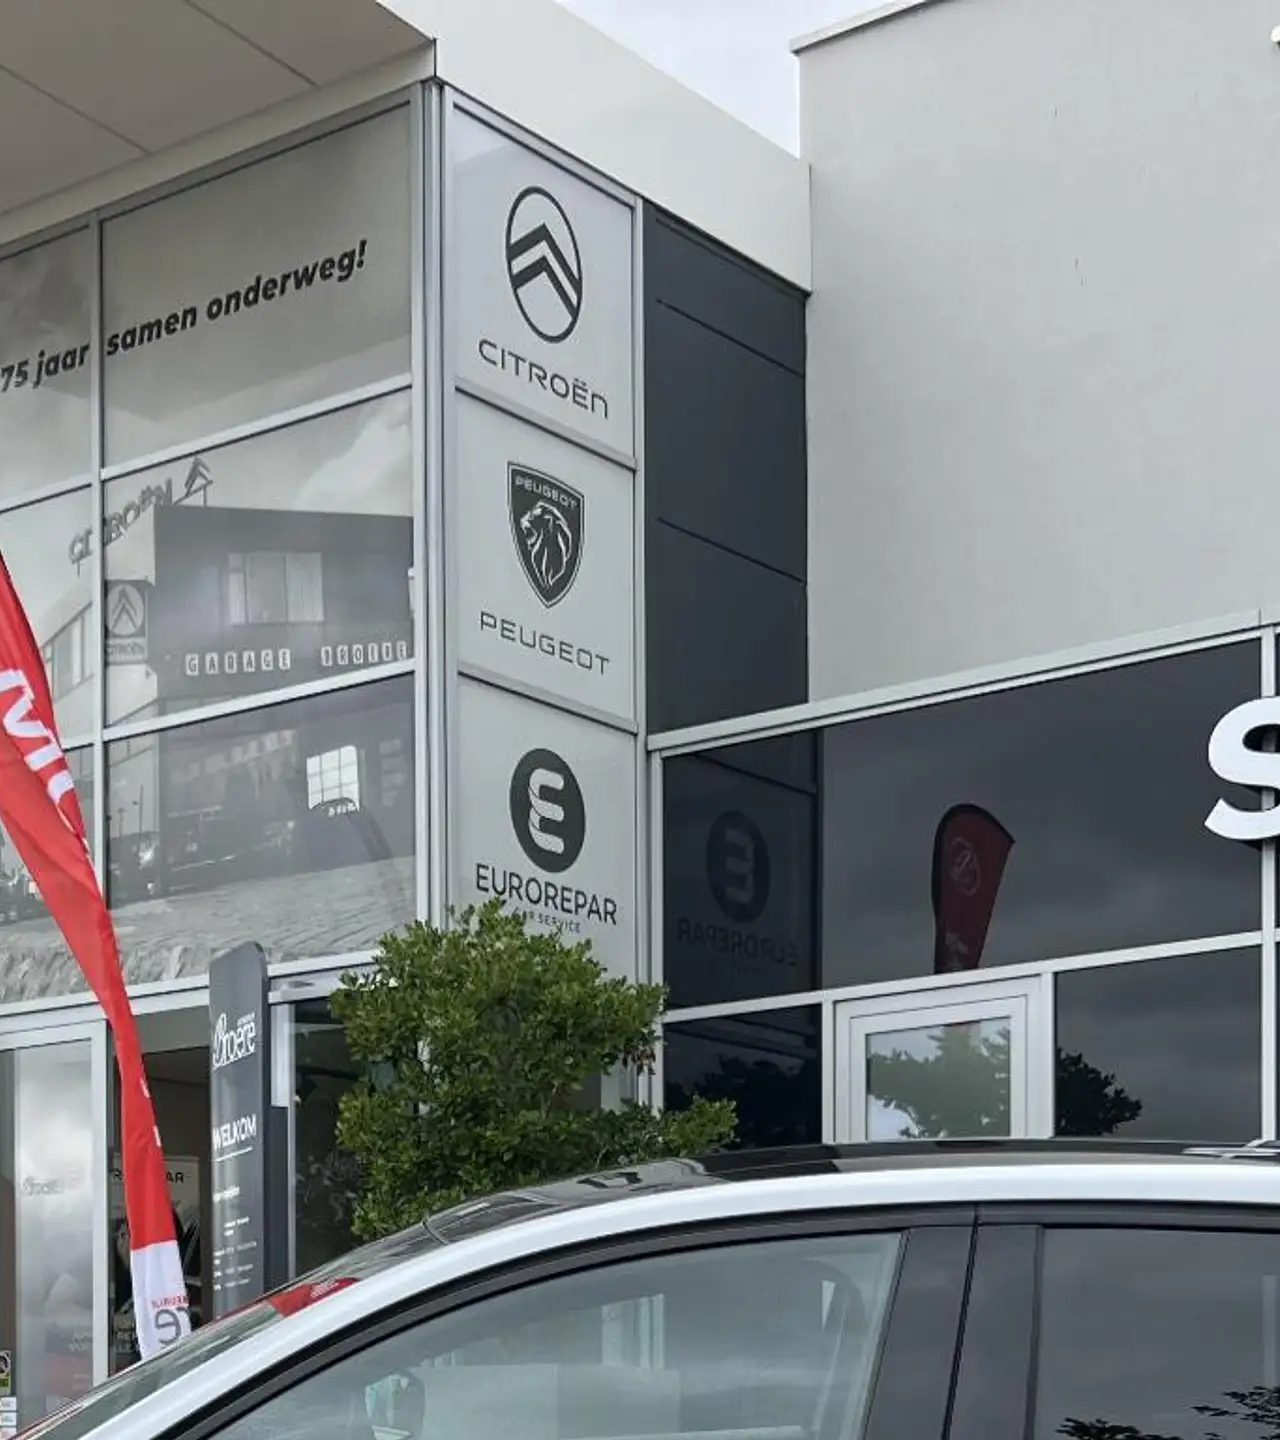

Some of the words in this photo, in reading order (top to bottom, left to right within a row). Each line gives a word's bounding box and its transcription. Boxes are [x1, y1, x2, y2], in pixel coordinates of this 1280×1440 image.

[0, 359, 29, 393] 75
[33, 343, 90, 389] jaar
[106, 305, 197, 356] samen
[206, 239, 368, 321] onderweg!
[515, 475, 578, 510] PEUGEOT
[480, 610, 610, 676] PEUGEOT
[475, 862, 618, 926] EUROREPAR
[212, 1114, 257, 1151] WELKOM
